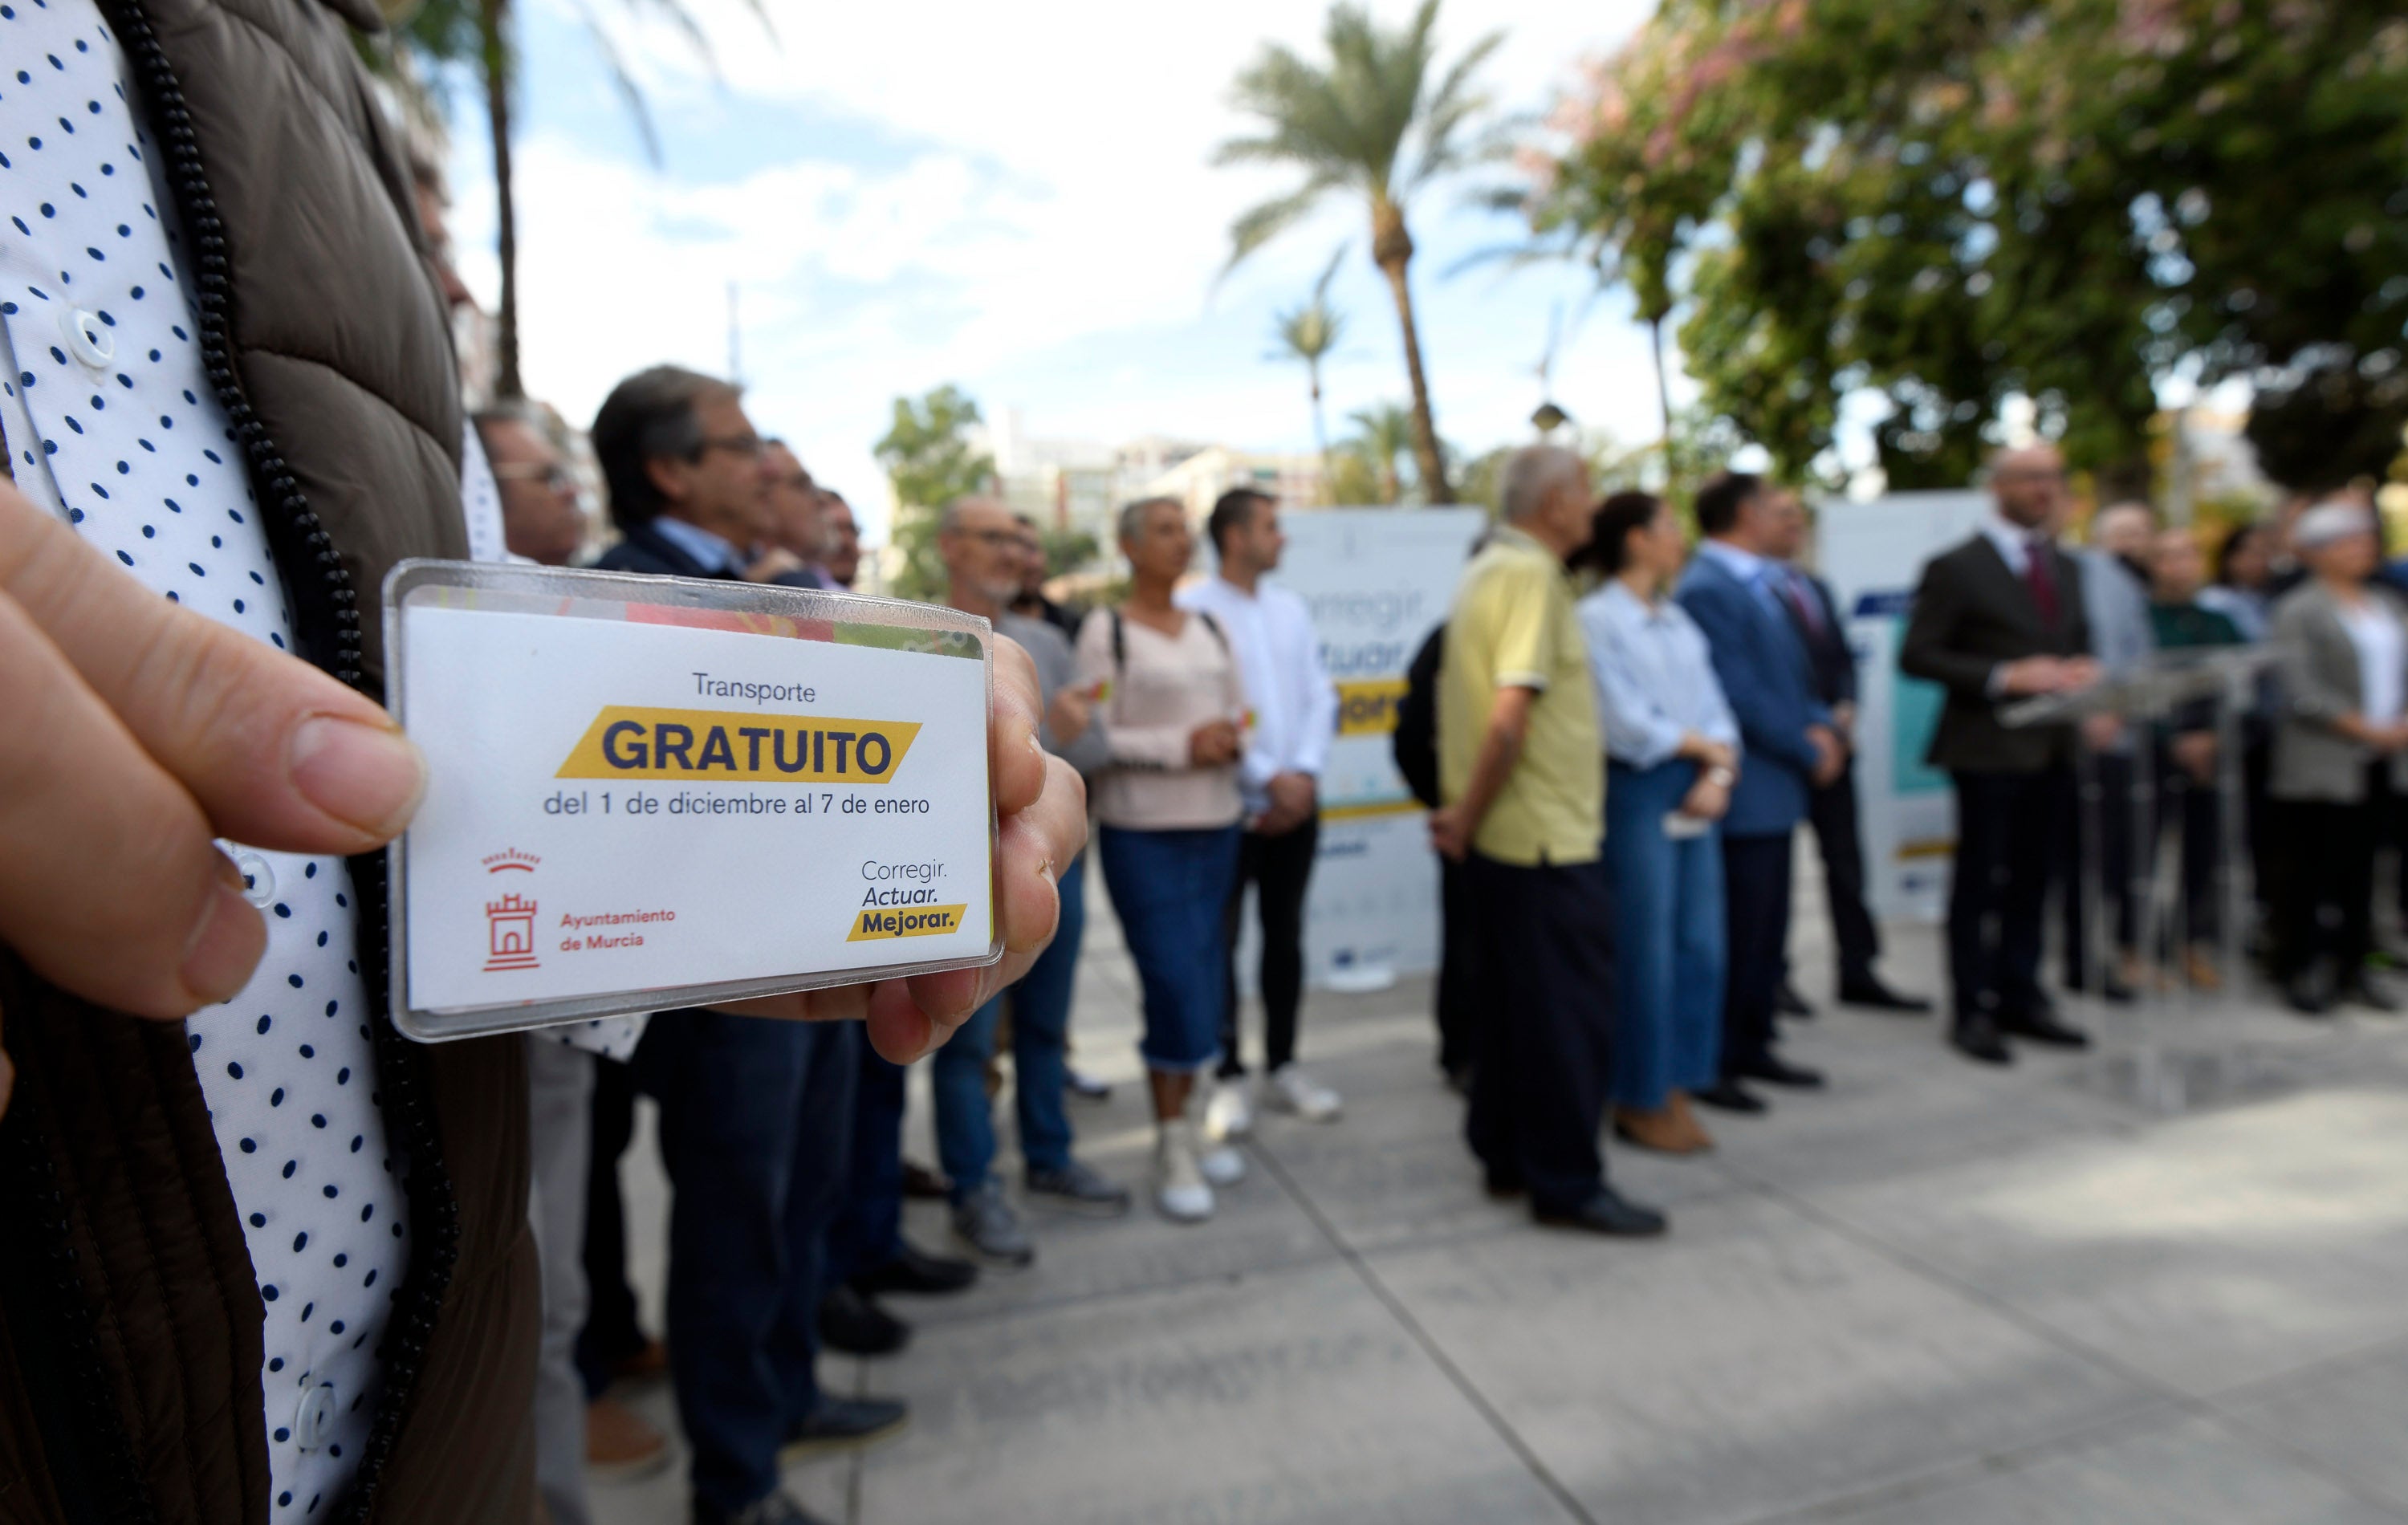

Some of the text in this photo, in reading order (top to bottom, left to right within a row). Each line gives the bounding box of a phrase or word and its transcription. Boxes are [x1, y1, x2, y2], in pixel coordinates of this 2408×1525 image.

[692, 672, 816, 706] Transporte
[602, 720, 892, 775] GRATUITO
[543, 791, 930, 815] del 1 de diciembre al 7 de enero
[861, 858, 948, 884] Corregir.
[861, 886, 938, 908] Actuar.
[559, 908, 676, 930] Ayuntamiento
[861, 910, 955, 937] Mejorar.
[559, 931, 645, 952] de Murcia
